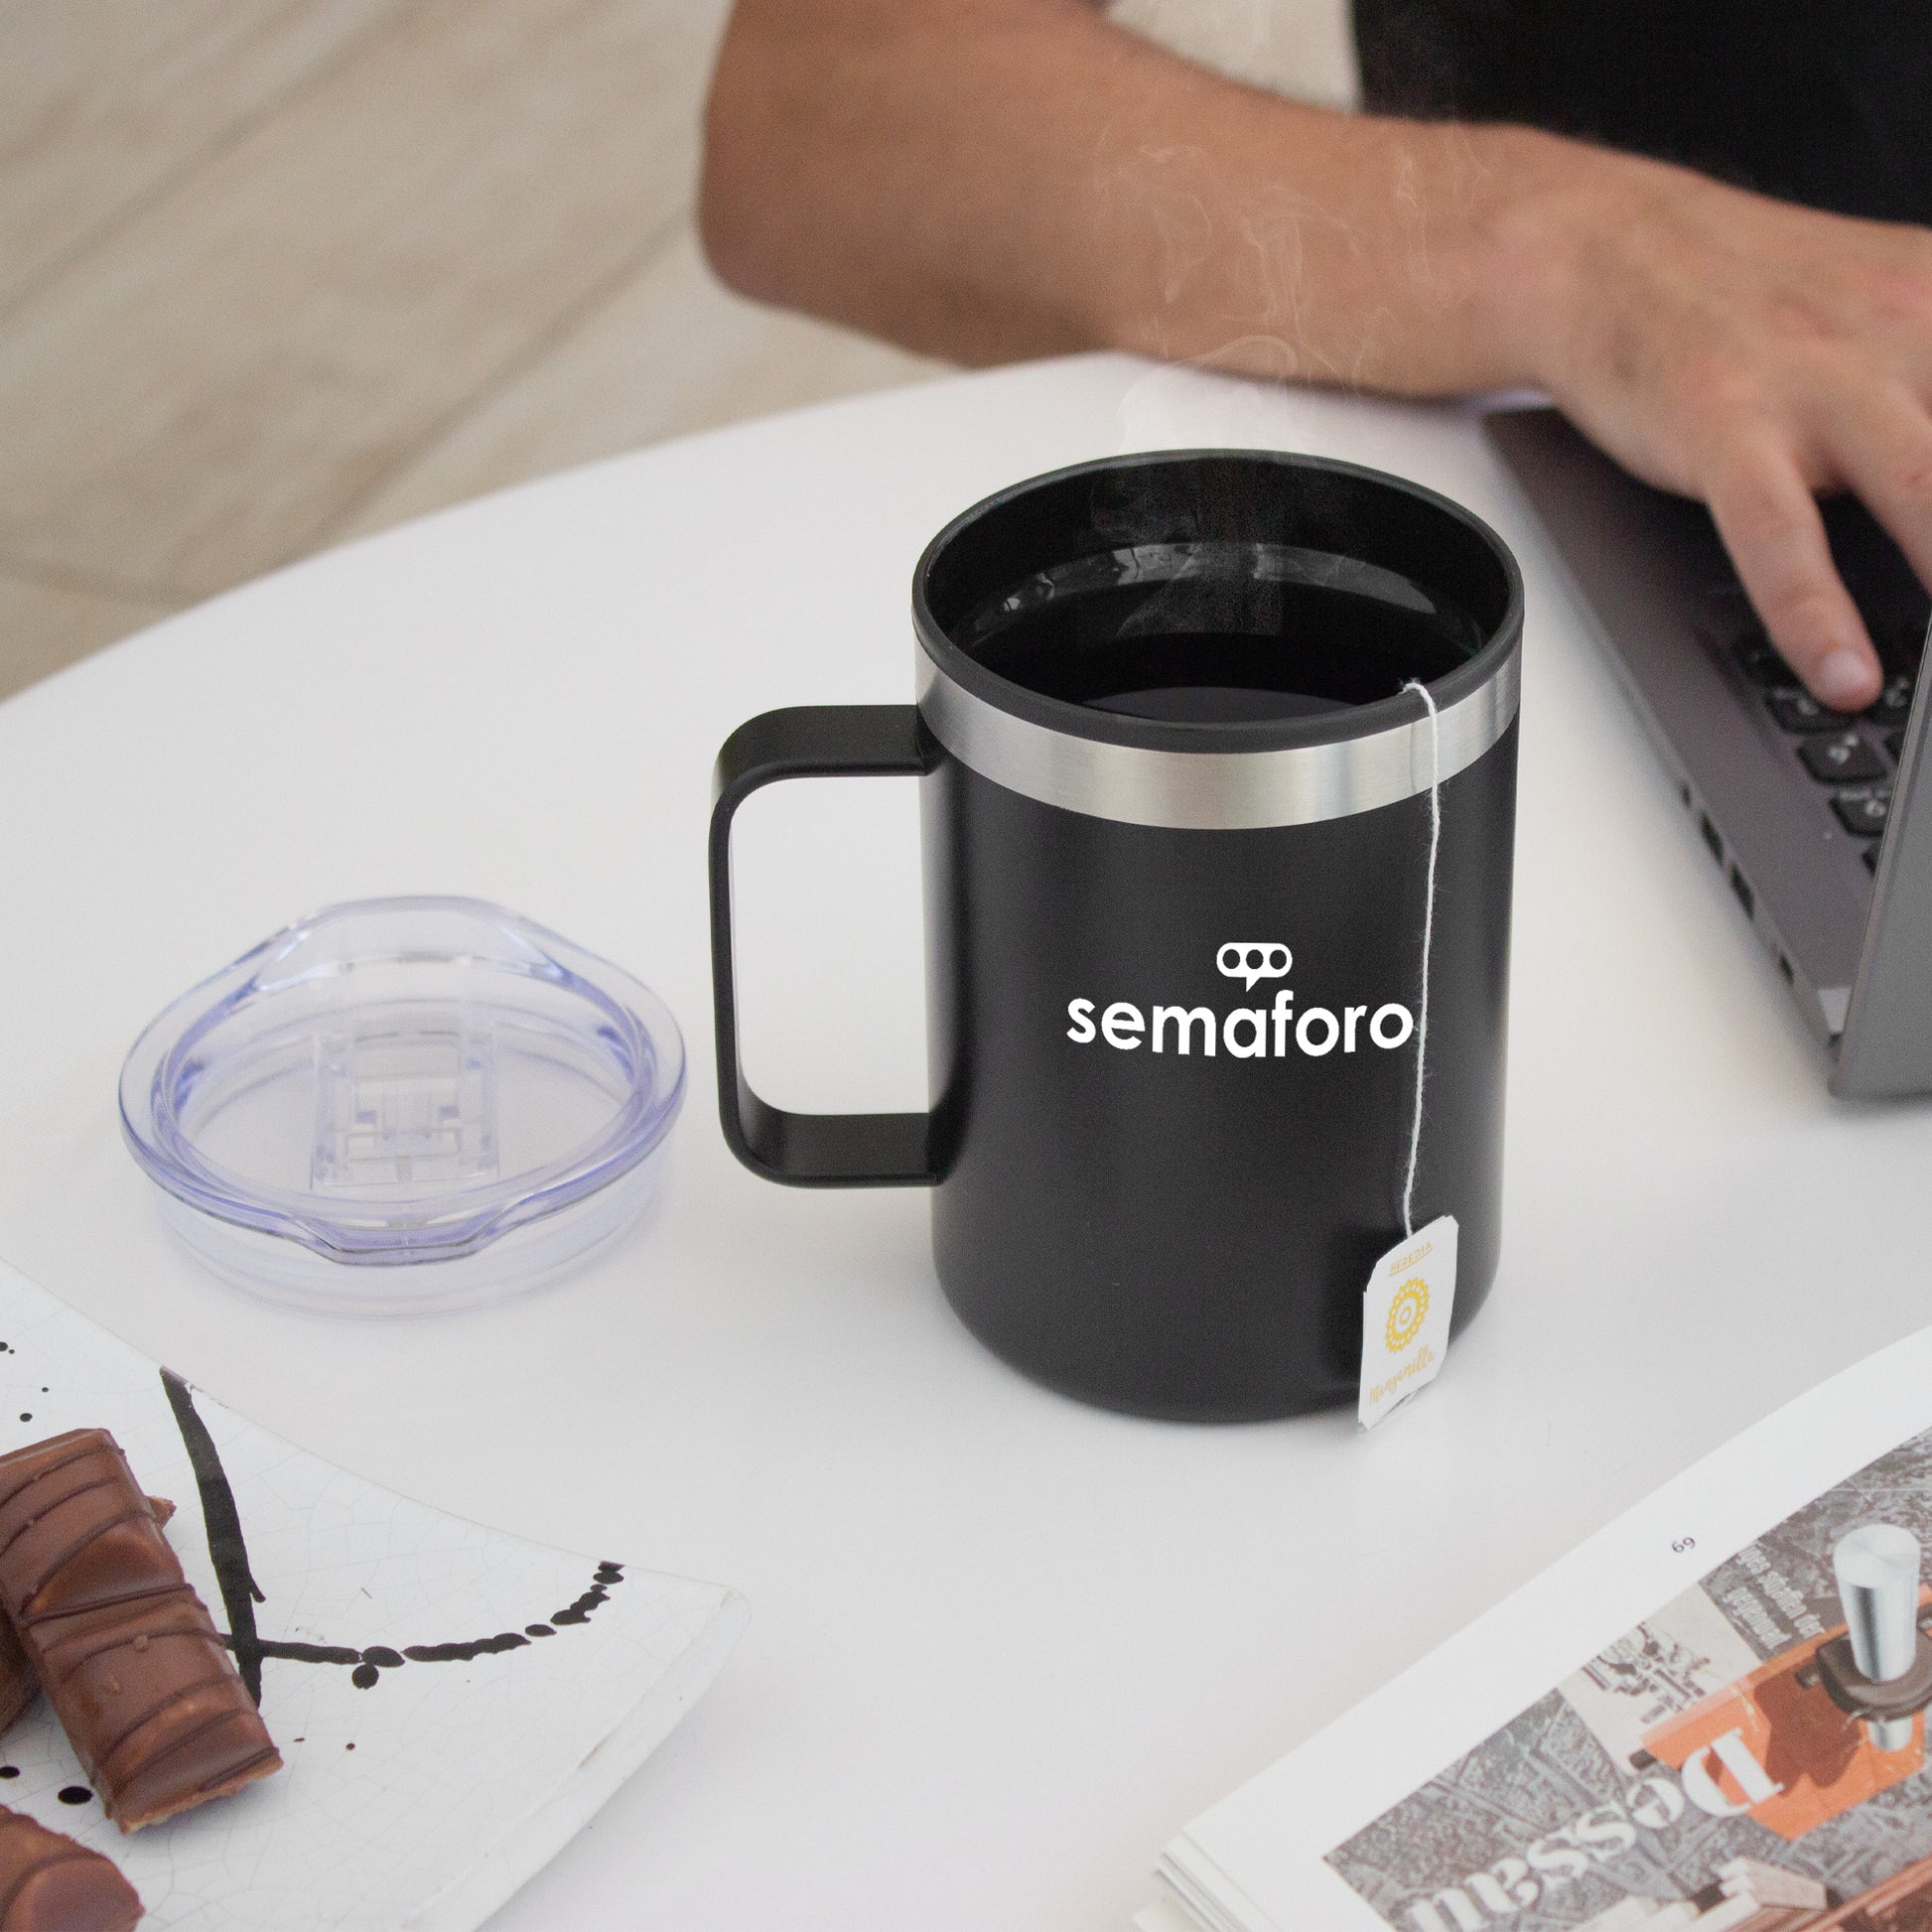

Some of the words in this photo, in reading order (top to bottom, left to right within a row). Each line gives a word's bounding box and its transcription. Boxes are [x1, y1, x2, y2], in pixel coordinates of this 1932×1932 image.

[1066, 990, 1414, 1058] semaforo
[1671, 1537, 1696, 1554] 69
[1406, 1726, 1784, 1932] Dessau
